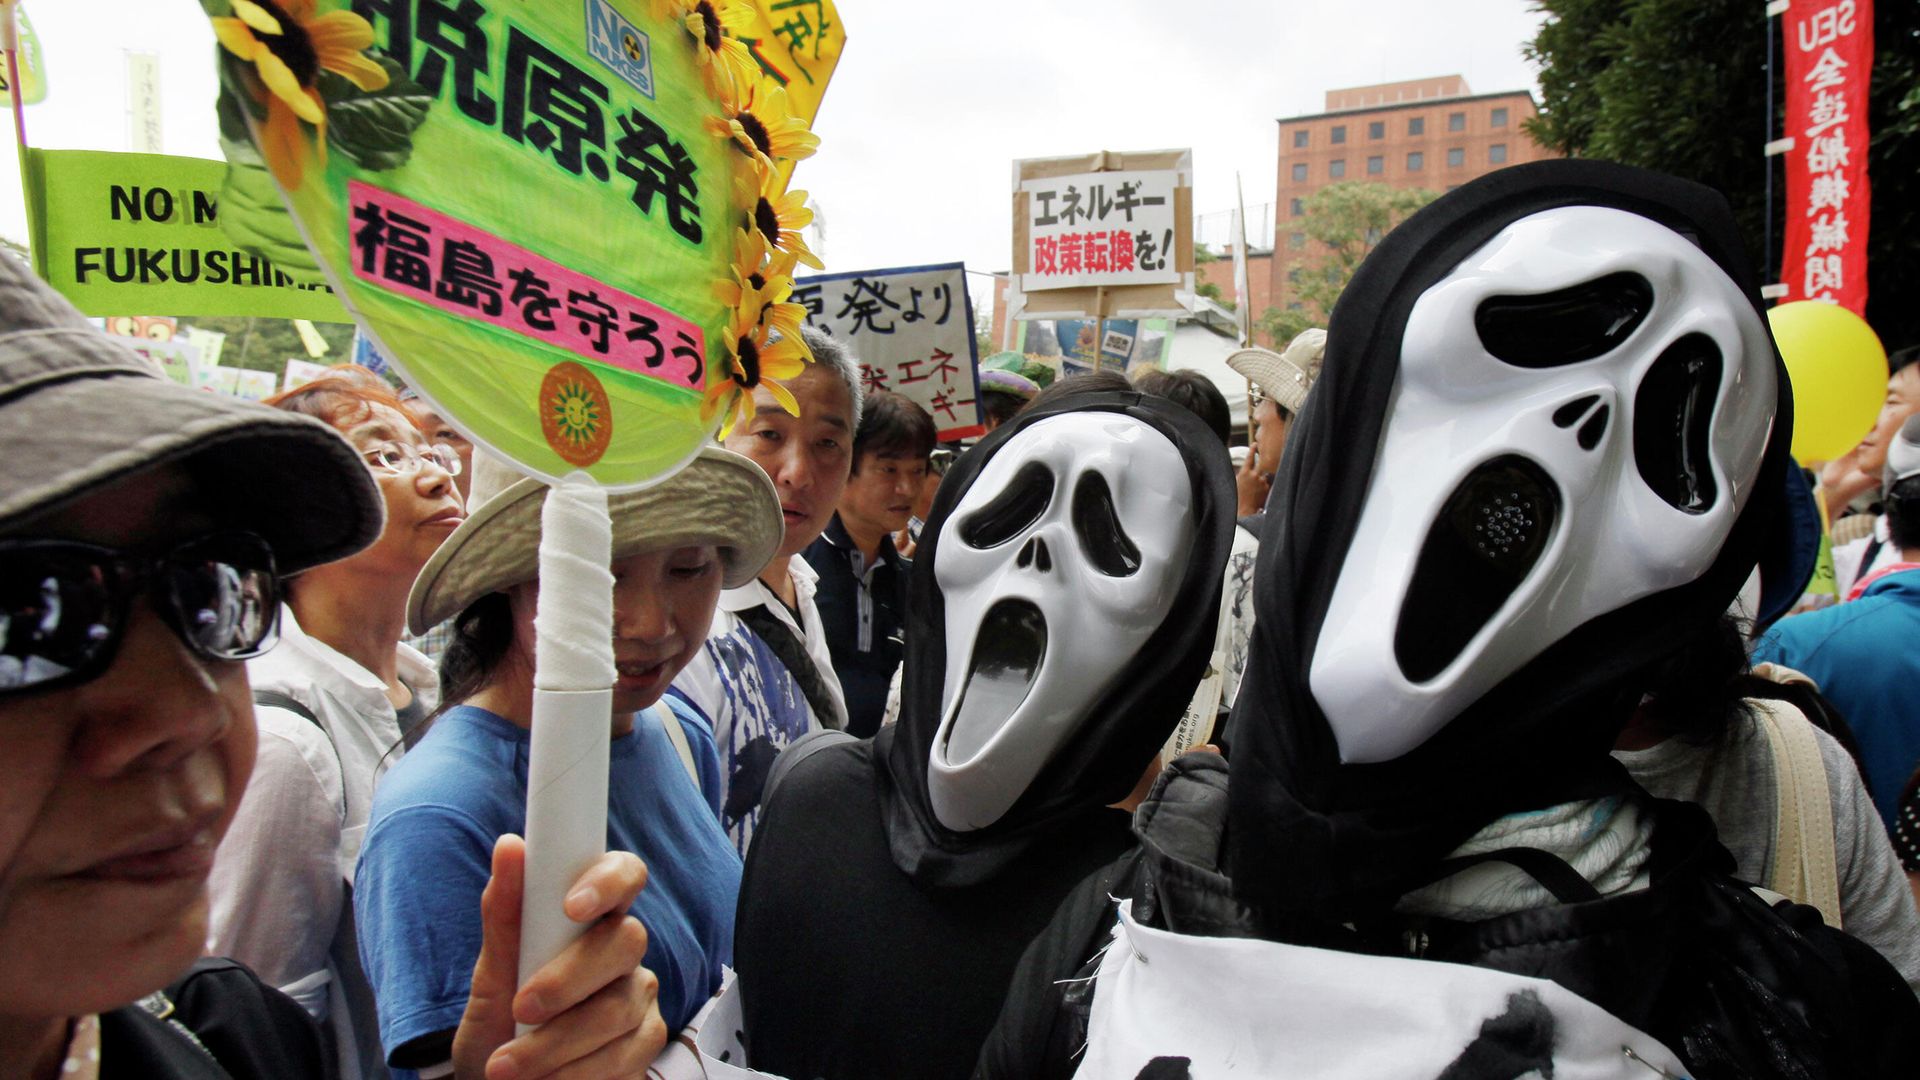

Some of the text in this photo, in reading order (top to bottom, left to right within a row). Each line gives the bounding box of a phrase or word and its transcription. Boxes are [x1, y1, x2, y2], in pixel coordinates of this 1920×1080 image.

[590, 0, 647, 70] NO
[592, 36, 649, 90] NUKES
[110, 185, 219, 224] NO M
[1034, 180, 1166, 226] エネルギー
[1034, 228, 1173, 277] 政策転換を!
[354, 201, 704, 385] 福島を守ろう
